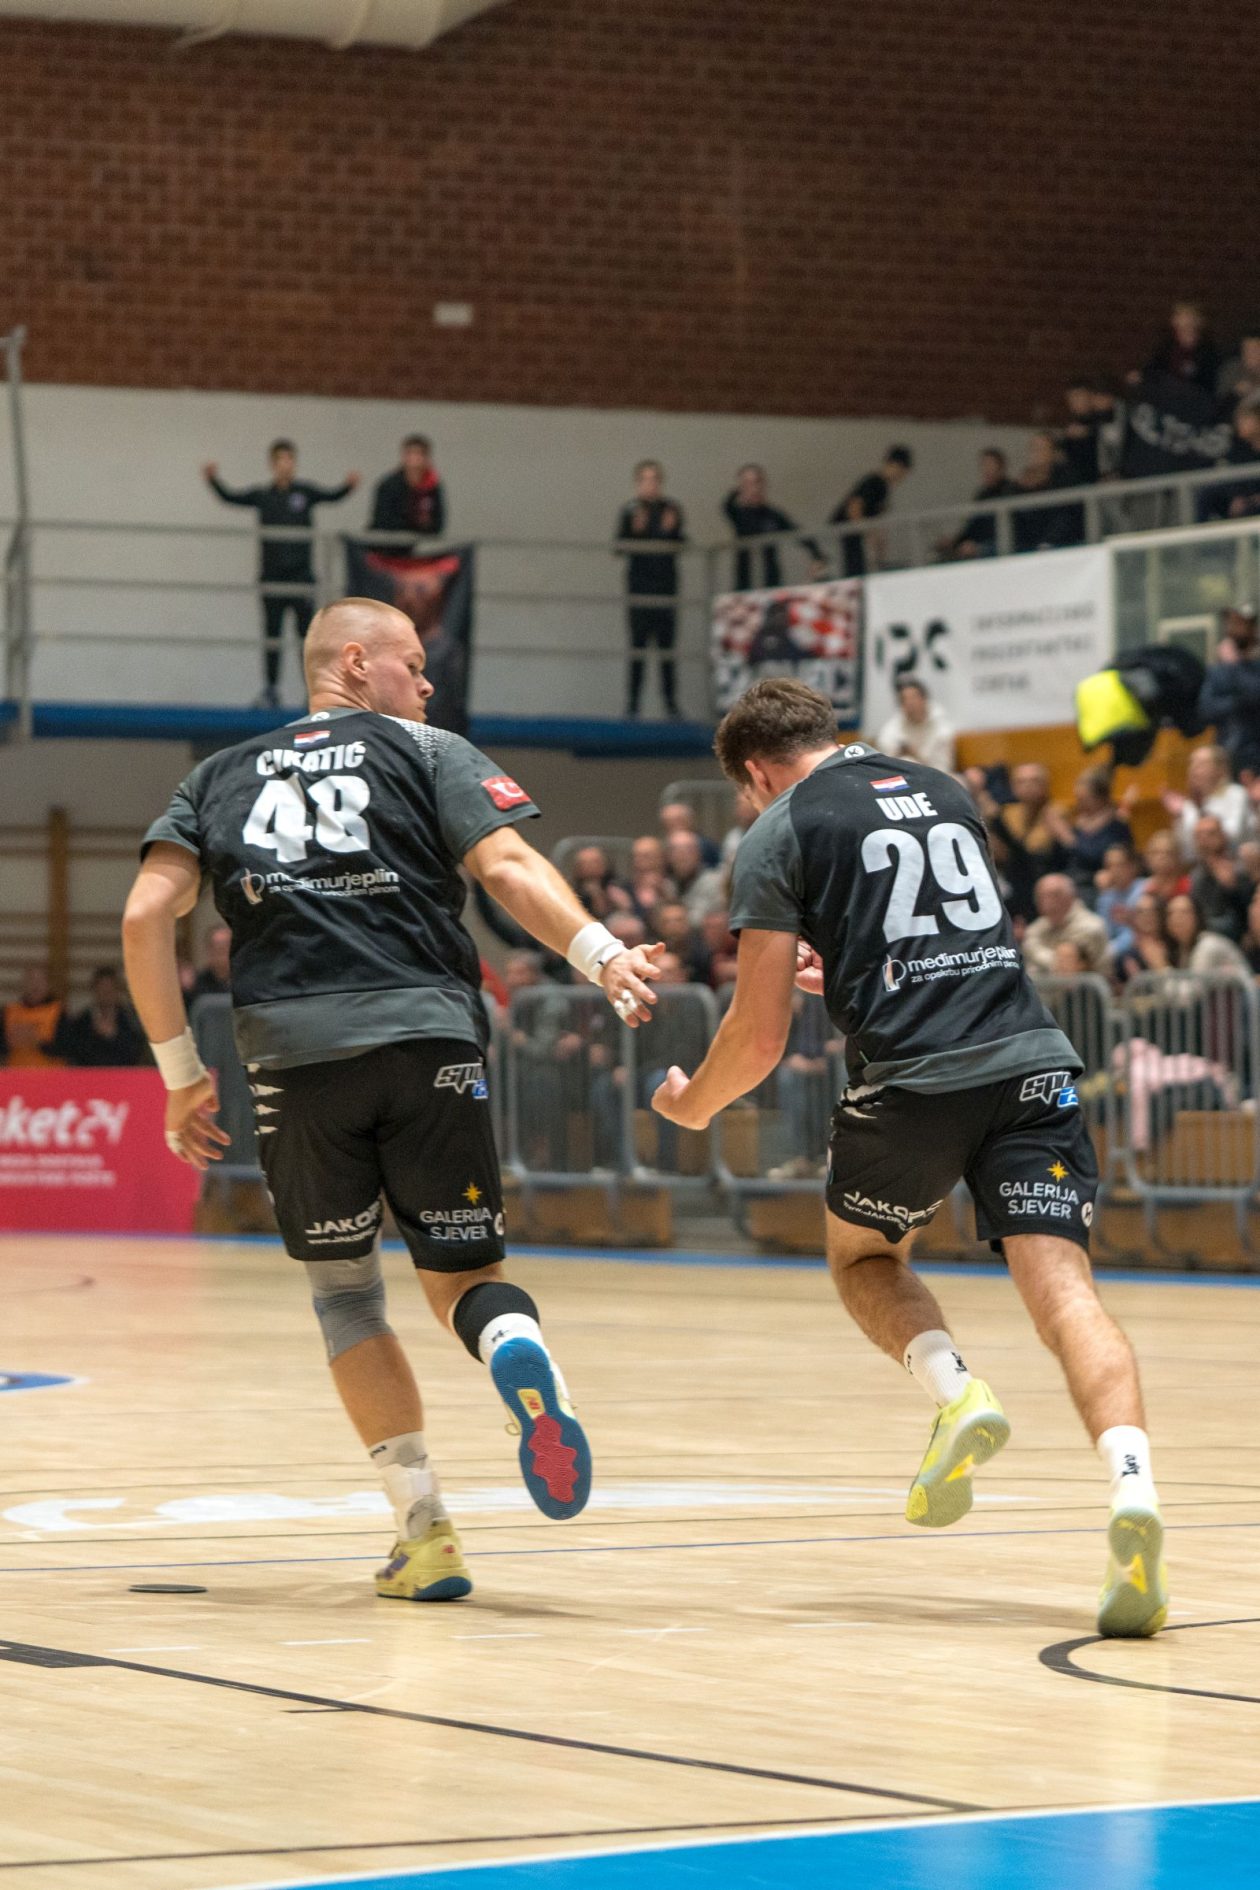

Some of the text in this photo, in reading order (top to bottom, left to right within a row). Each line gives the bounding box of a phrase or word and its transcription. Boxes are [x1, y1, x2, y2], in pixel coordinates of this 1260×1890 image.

[242, 772, 370, 863] 48
[875, 792, 938, 821] UDE
[861, 822, 1002, 943] 29
[911, 974, 923, 983] za
[0, 1095, 129, 1147] ket24
[999, 1181, 1080, 1206] GALERIJA
[419, 1207, 493, 1224] GALERIJA
[1007, 1199, 1072, 1219] SJEVER
[429, 1225, 488, 1240] SJEVER
